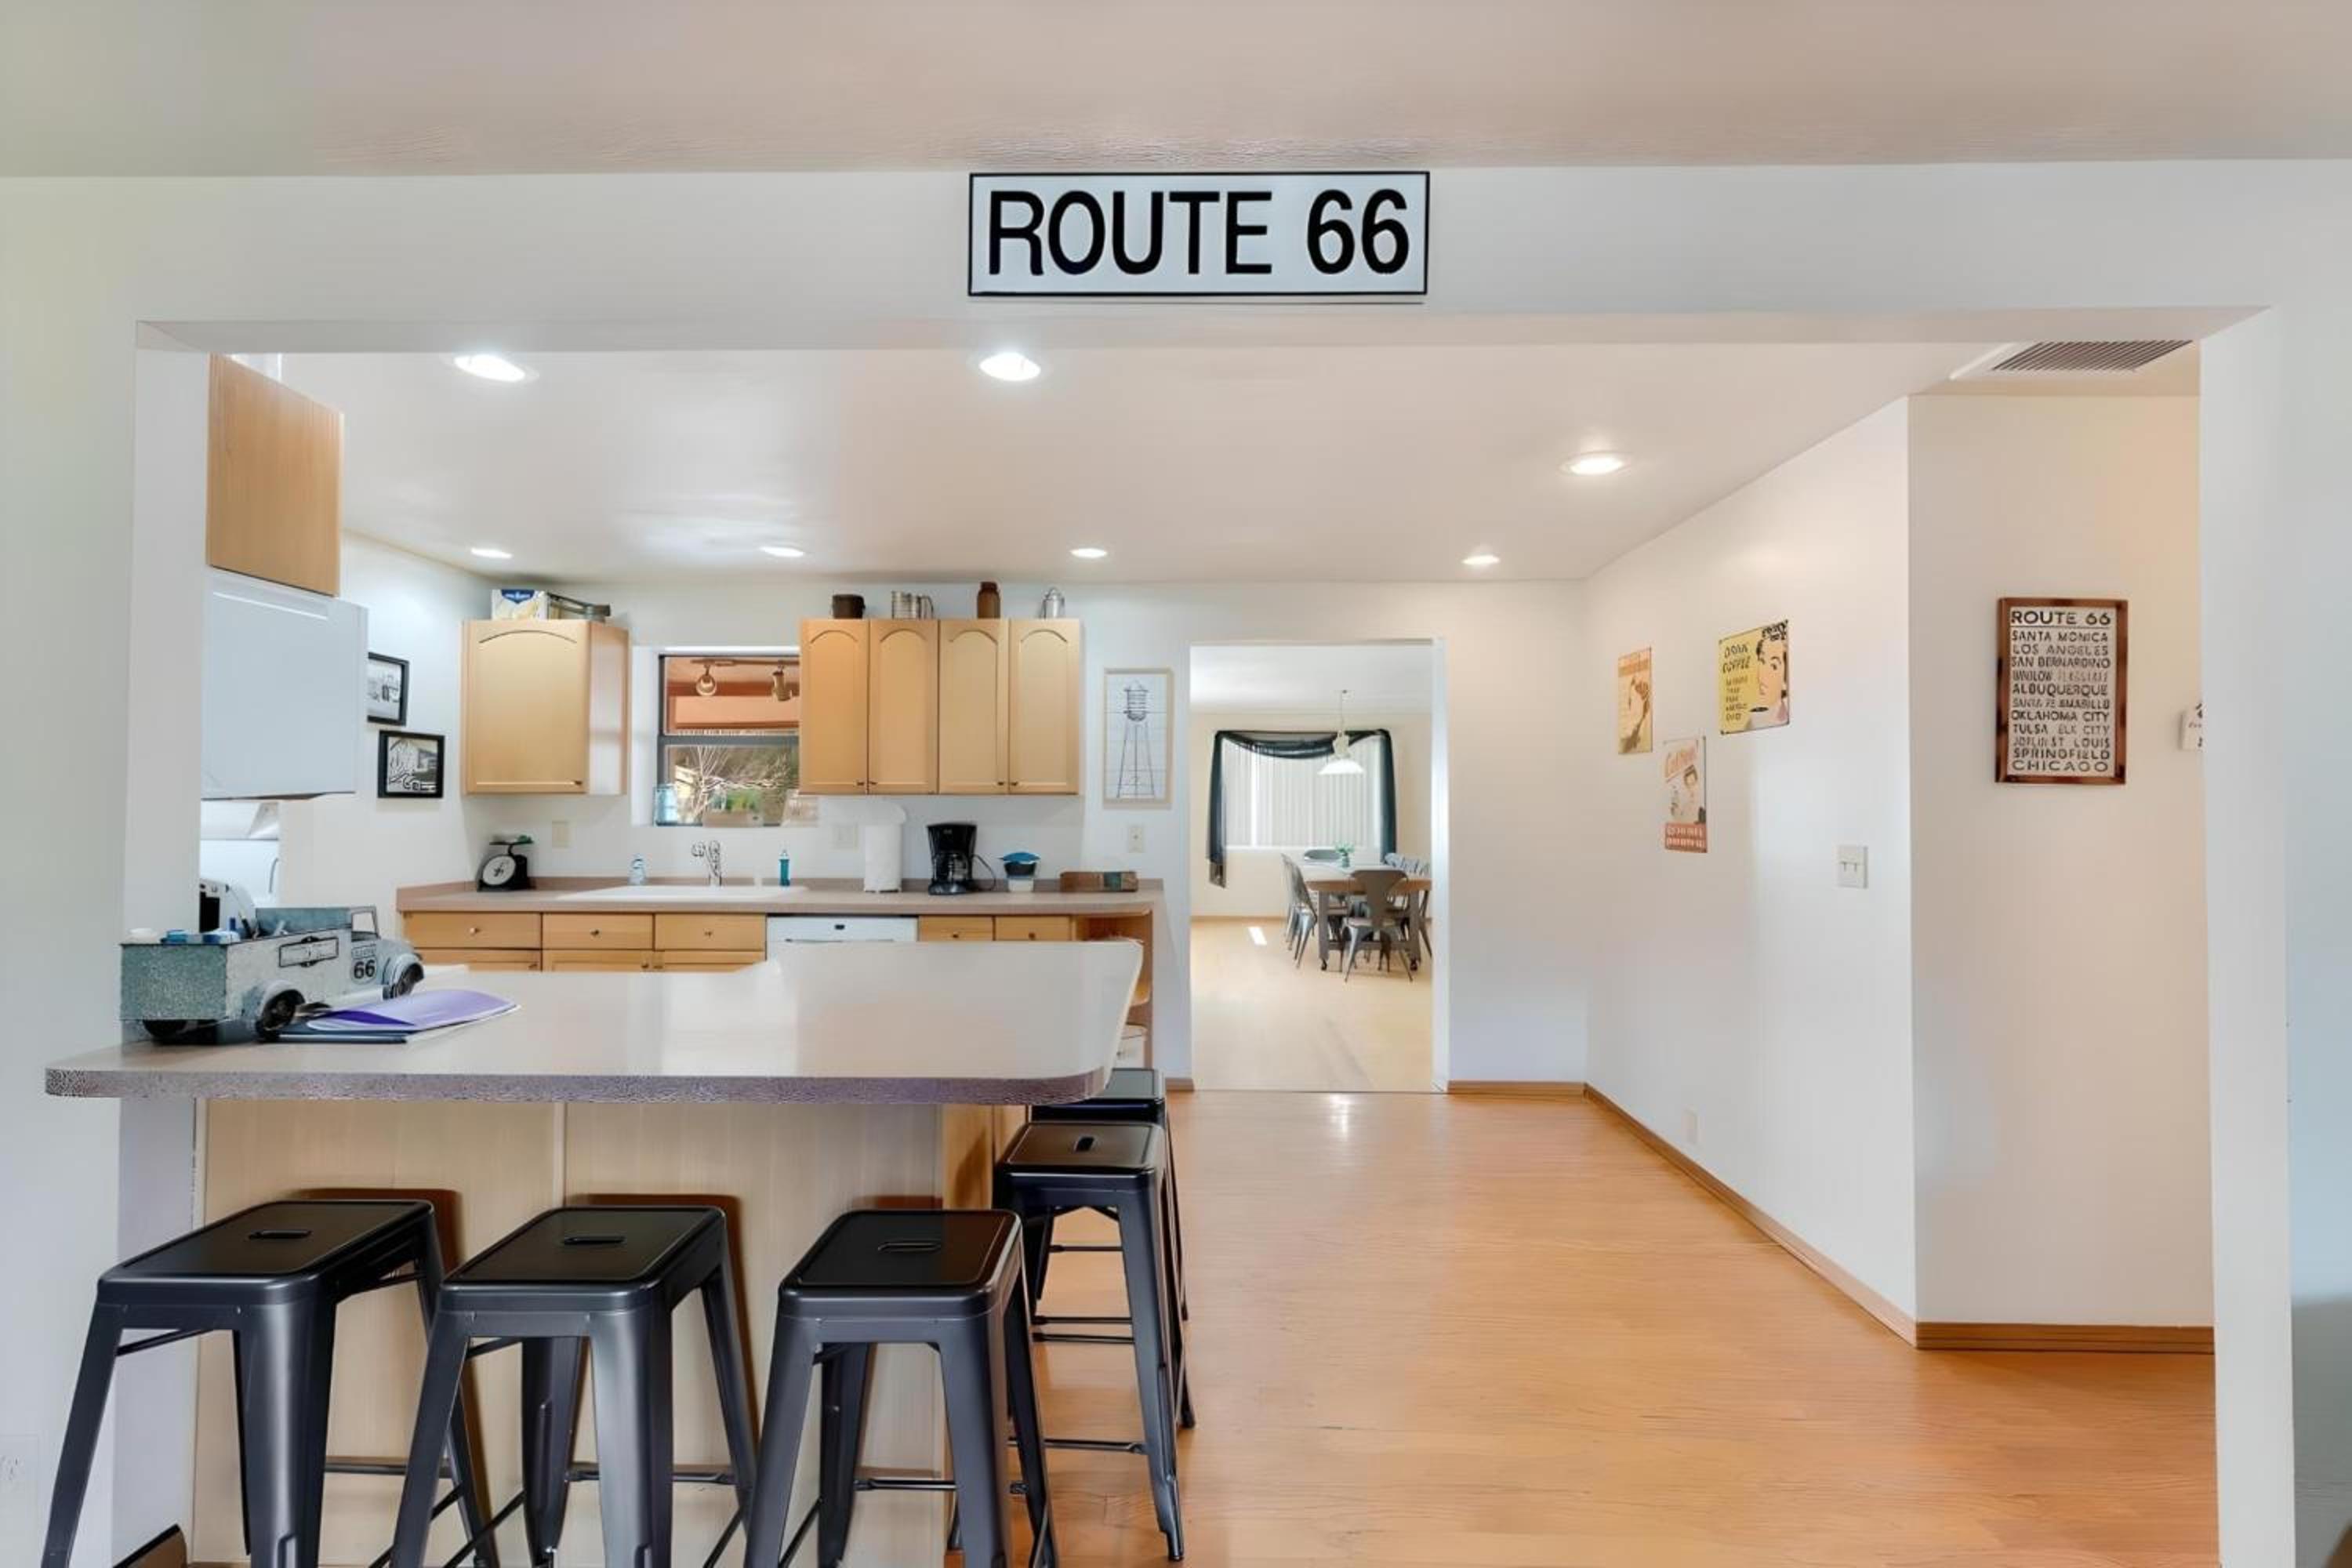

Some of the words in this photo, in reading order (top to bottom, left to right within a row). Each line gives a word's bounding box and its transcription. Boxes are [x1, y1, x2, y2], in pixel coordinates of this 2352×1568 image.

[989, 190, 1272, 275] ROUTE
[1306, 188, 1410, 274] 66
[2011, 611, 2077, 624] ROUTE
[2085, 612, 2111, 625] 66
[2012, 630, 2052, 641] SANTA
[2058, 631, 2108, 642] MONICA
[2013, 644, 2038, 655] LOS
[2012, 656, 2034, 668] SAN
[2011, 710, 2078, 721] OKLAHOMA
[2082, 711, 2110, 722] CITY
[2013, 724, 2048, 735] TULSA
[2083, 725, 2111, 735] CITY
[2074, 738, 2111, 749] LOUIS
[354, 959, 376, 979] 66
